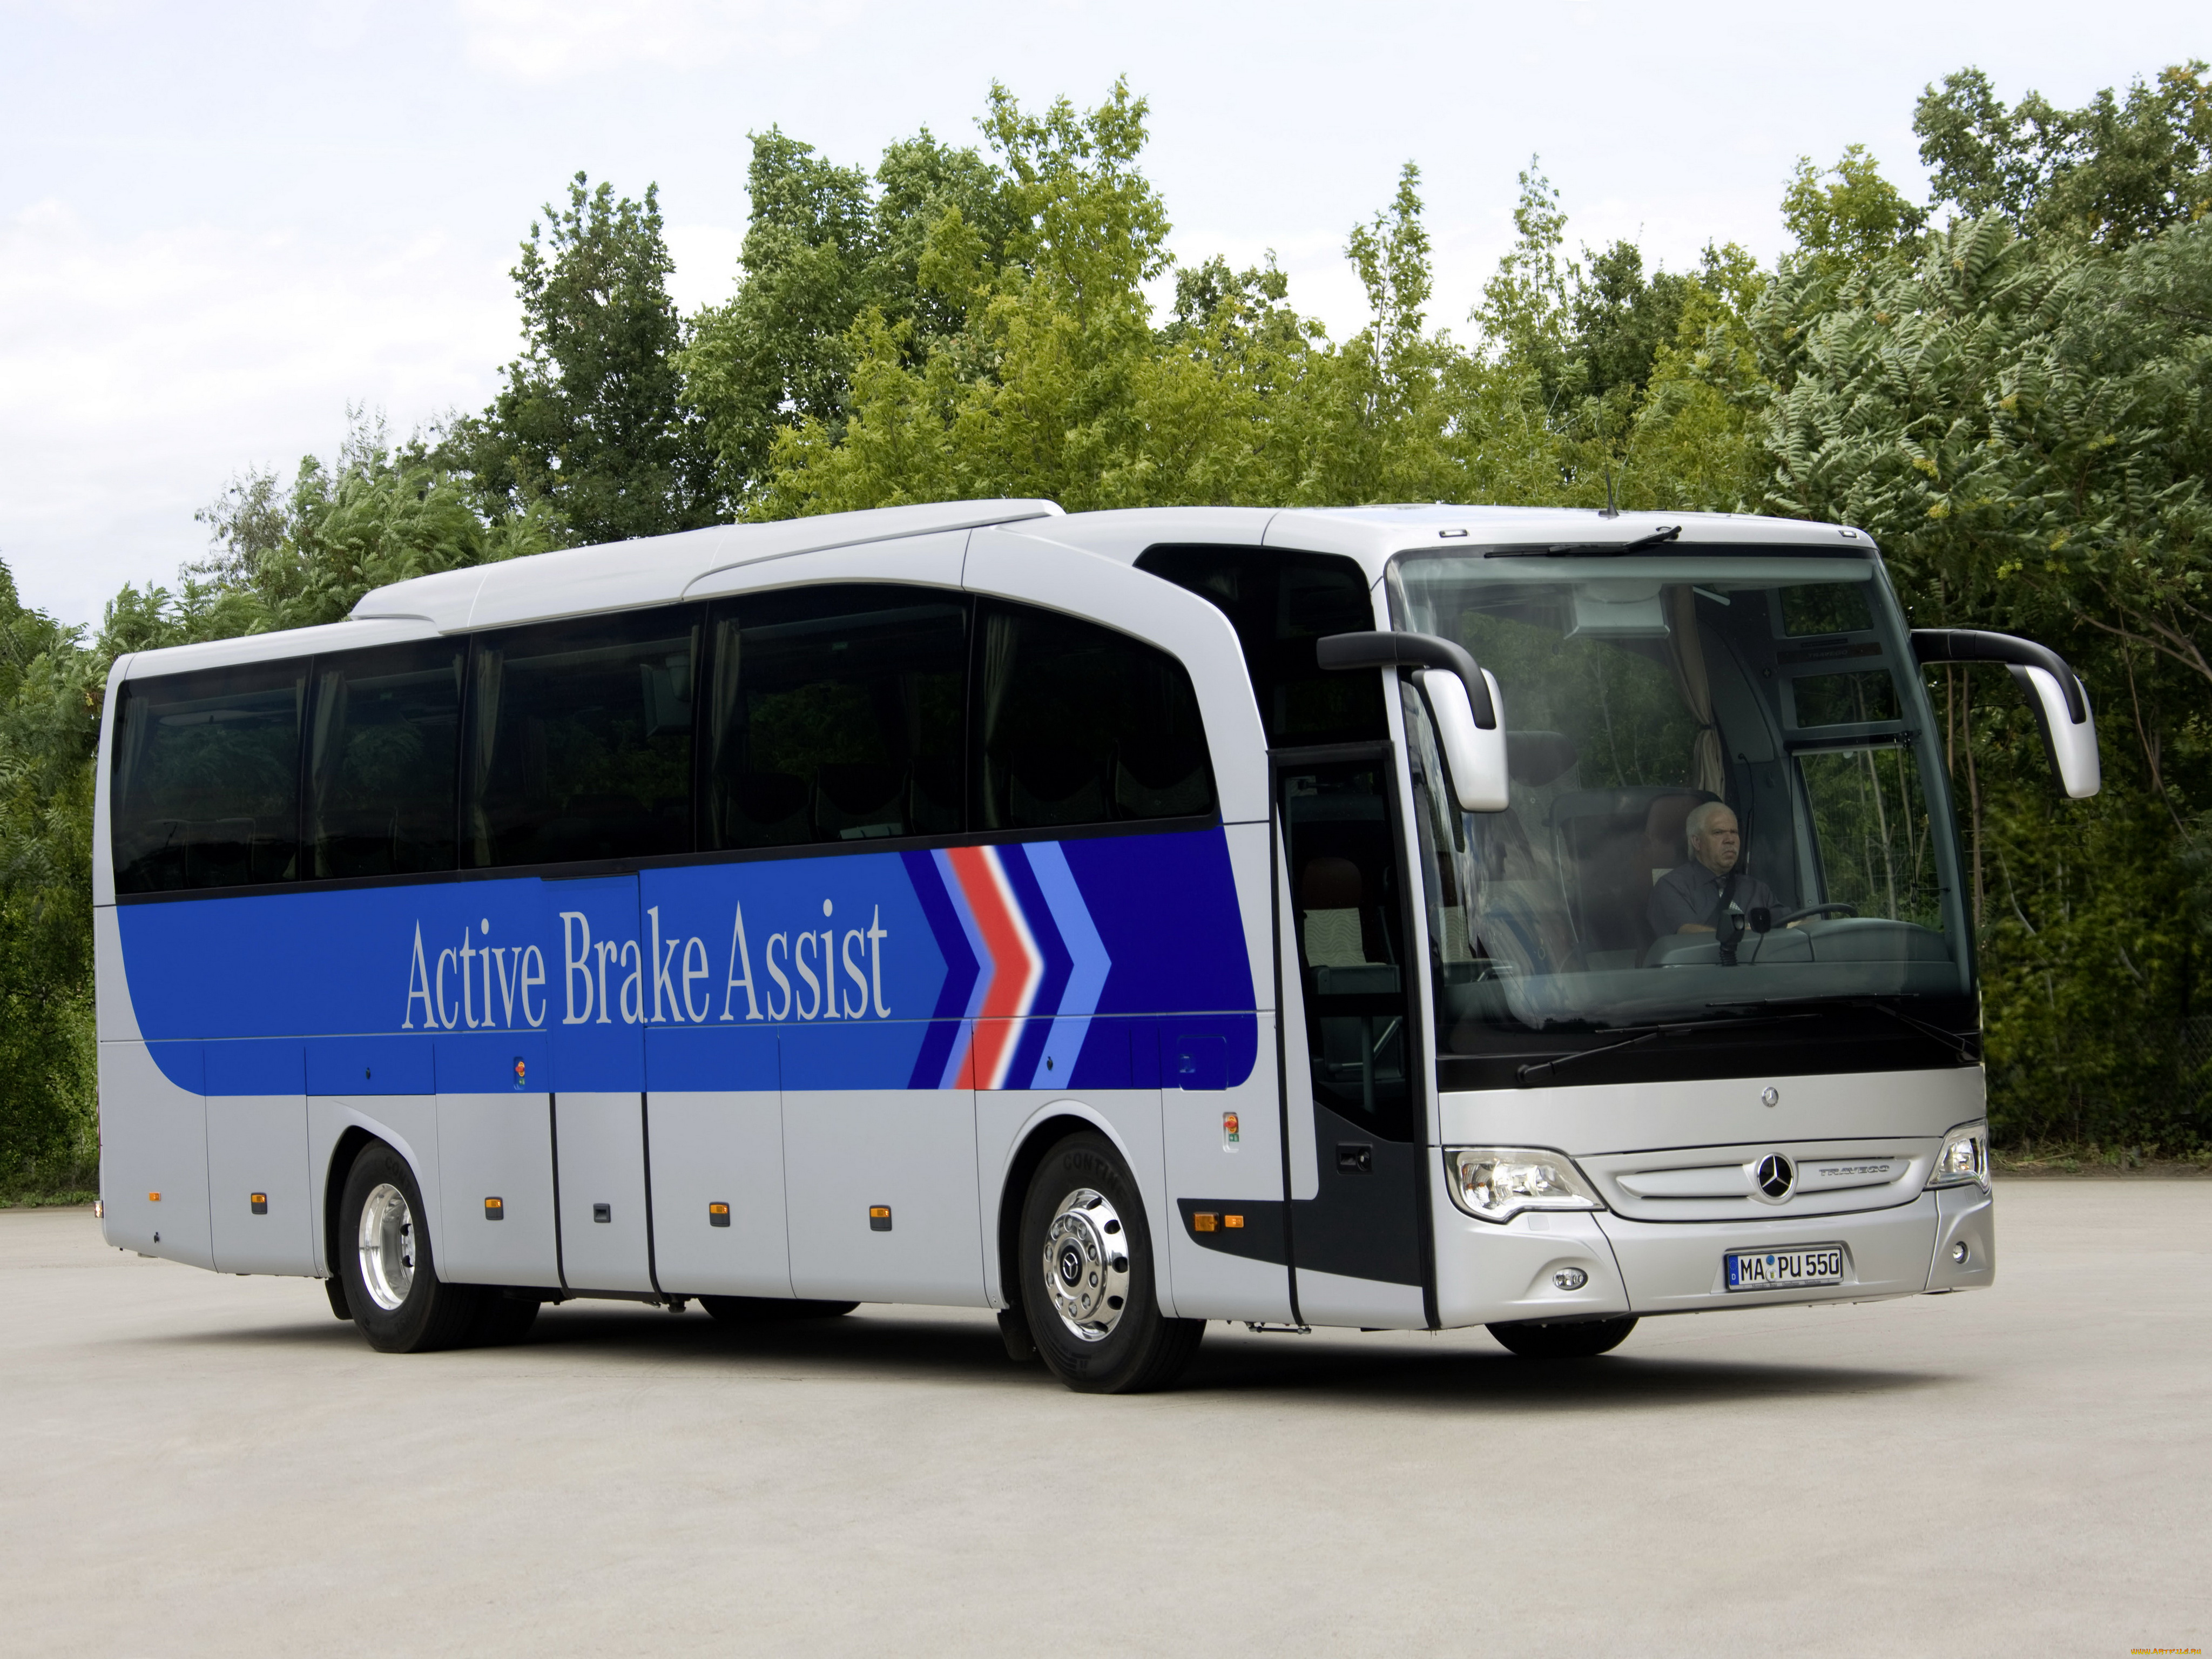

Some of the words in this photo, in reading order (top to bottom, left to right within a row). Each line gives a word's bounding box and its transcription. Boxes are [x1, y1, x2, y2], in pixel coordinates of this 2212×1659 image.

[402, 918, 546, 1029] Active
[559, 906, 710, 1024] Brake
[720, 899, 891, 1021] Assist
[1819, 1165, 1890, 1176] TRAVEGO
[1741, 1258, 1765, 1281] MA
[1778, 1255, 1802, 1278] PU
[1806, 1253, 1839, 1276] 550
